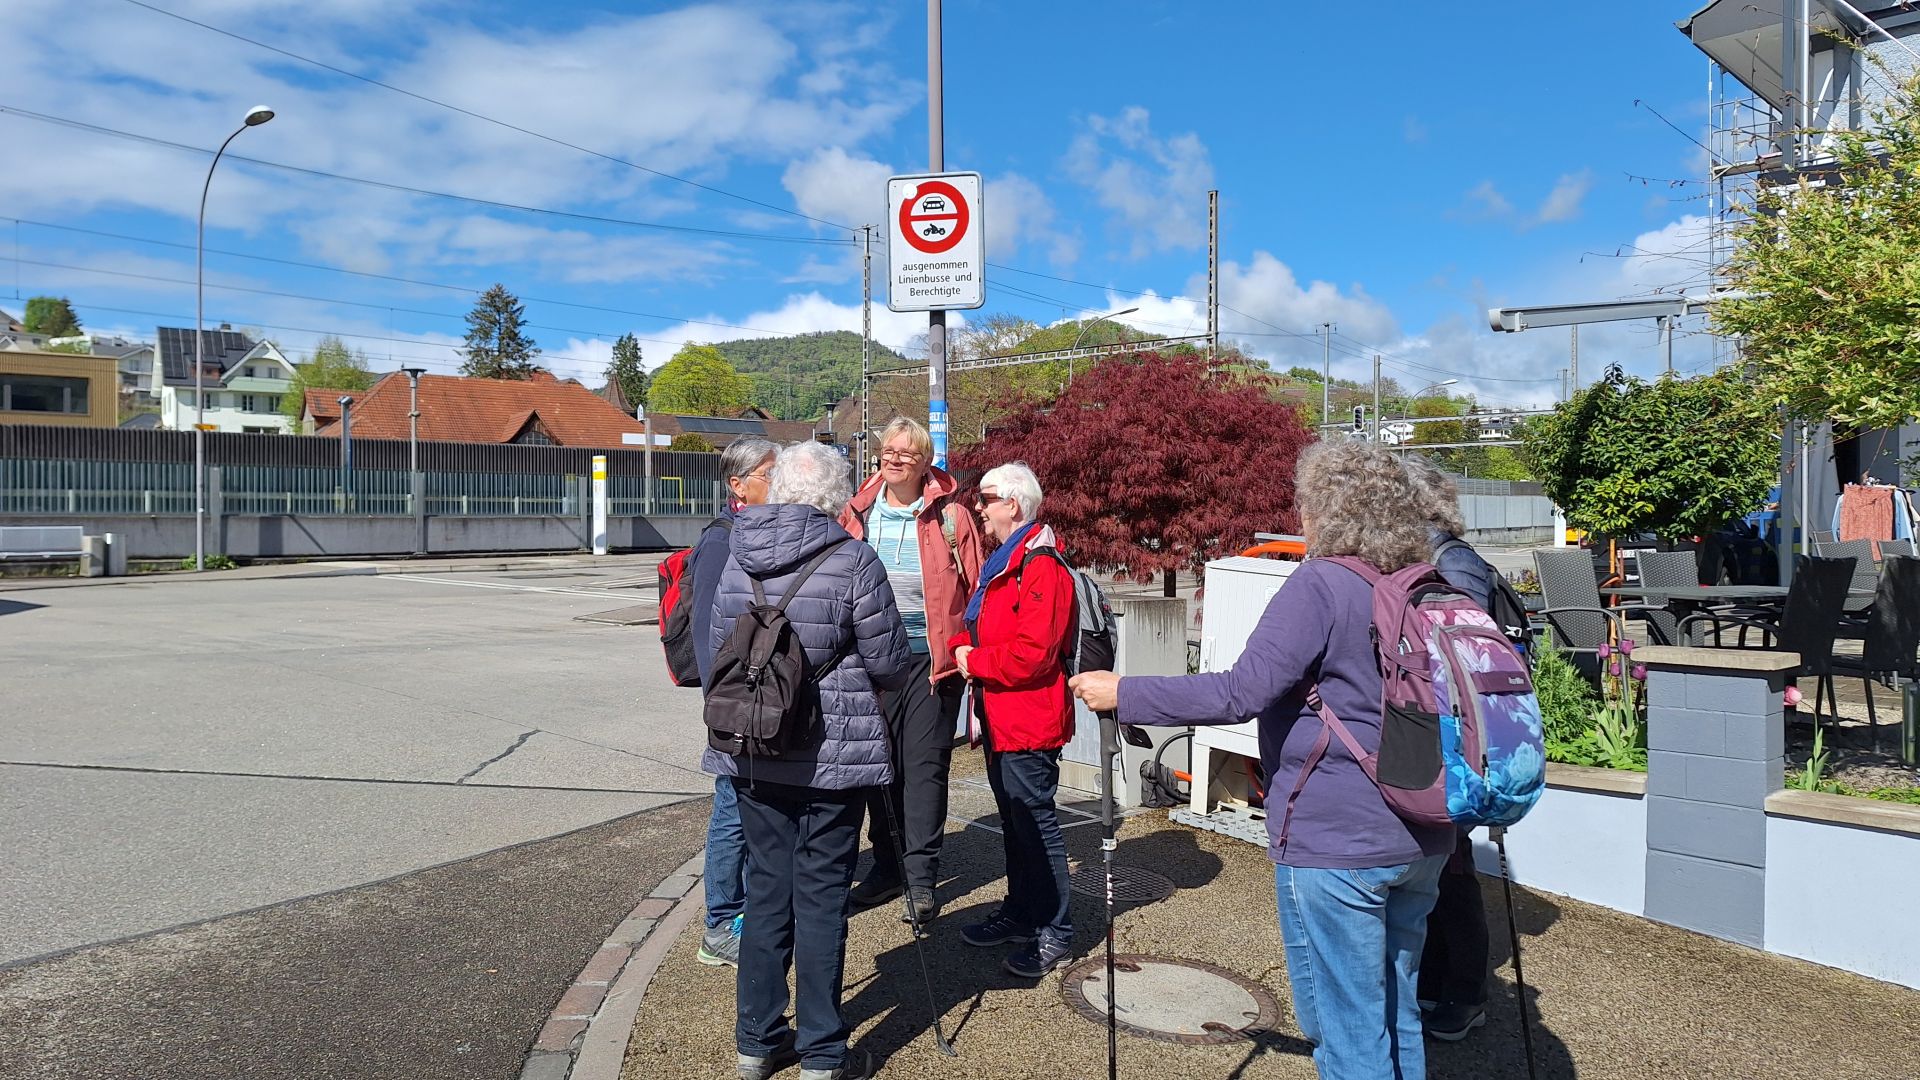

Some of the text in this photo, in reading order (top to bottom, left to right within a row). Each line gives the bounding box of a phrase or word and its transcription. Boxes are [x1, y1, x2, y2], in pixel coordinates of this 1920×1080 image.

[902, 261, 968, 272] ausgenommen
[898, 272, 972, 284] Linienbusse und
[909, 286, 961, 297] Berechtigte
